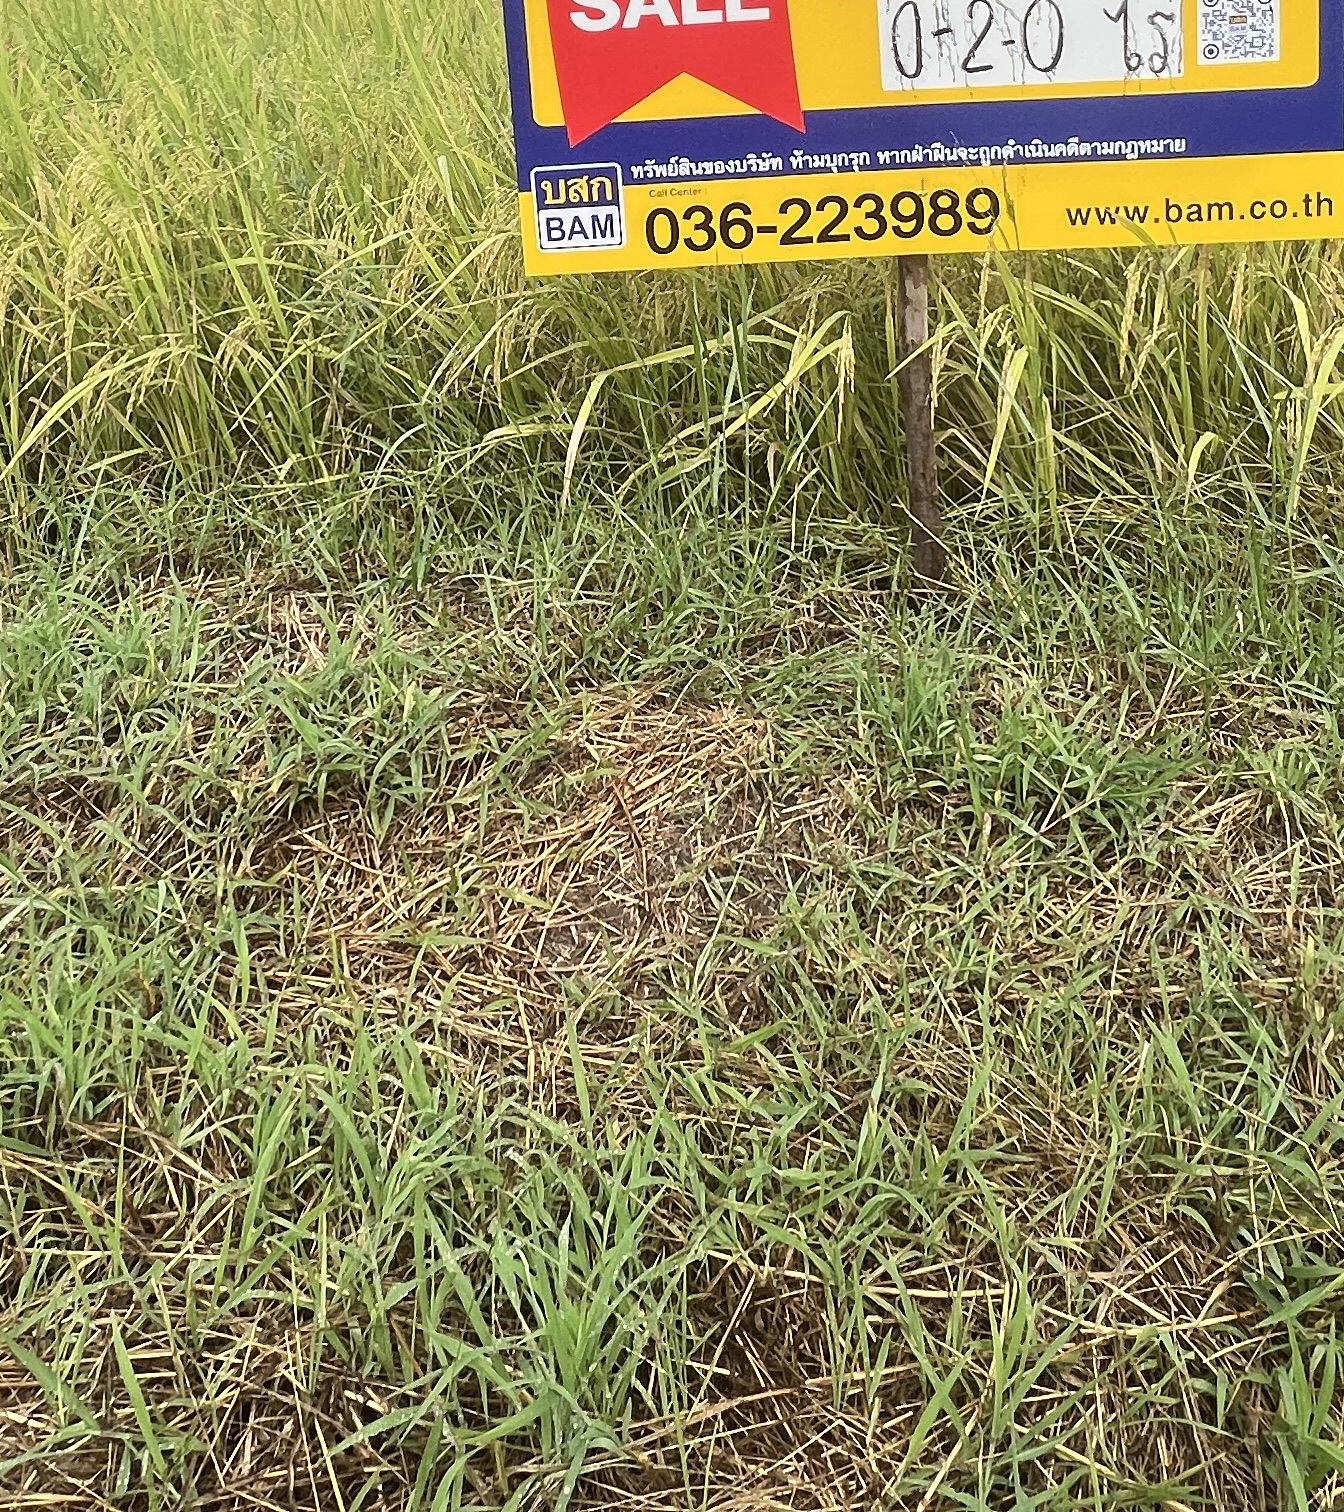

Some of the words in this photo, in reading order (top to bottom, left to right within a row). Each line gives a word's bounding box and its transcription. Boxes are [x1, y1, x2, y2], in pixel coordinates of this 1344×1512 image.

[630, 154, 784, 180] ทรัพย์สินของบริษัท
[789, 149, 871, 173] ห้ามบุกรุก
[540, 174, 615, 205] บสก
[648, 188, 668, 198] Call
[645, 187, 1001, 256] 036-223989
[1065, 192, 1336, 226] www.bam.co.th
[544, 213, 616, 243] BAM
